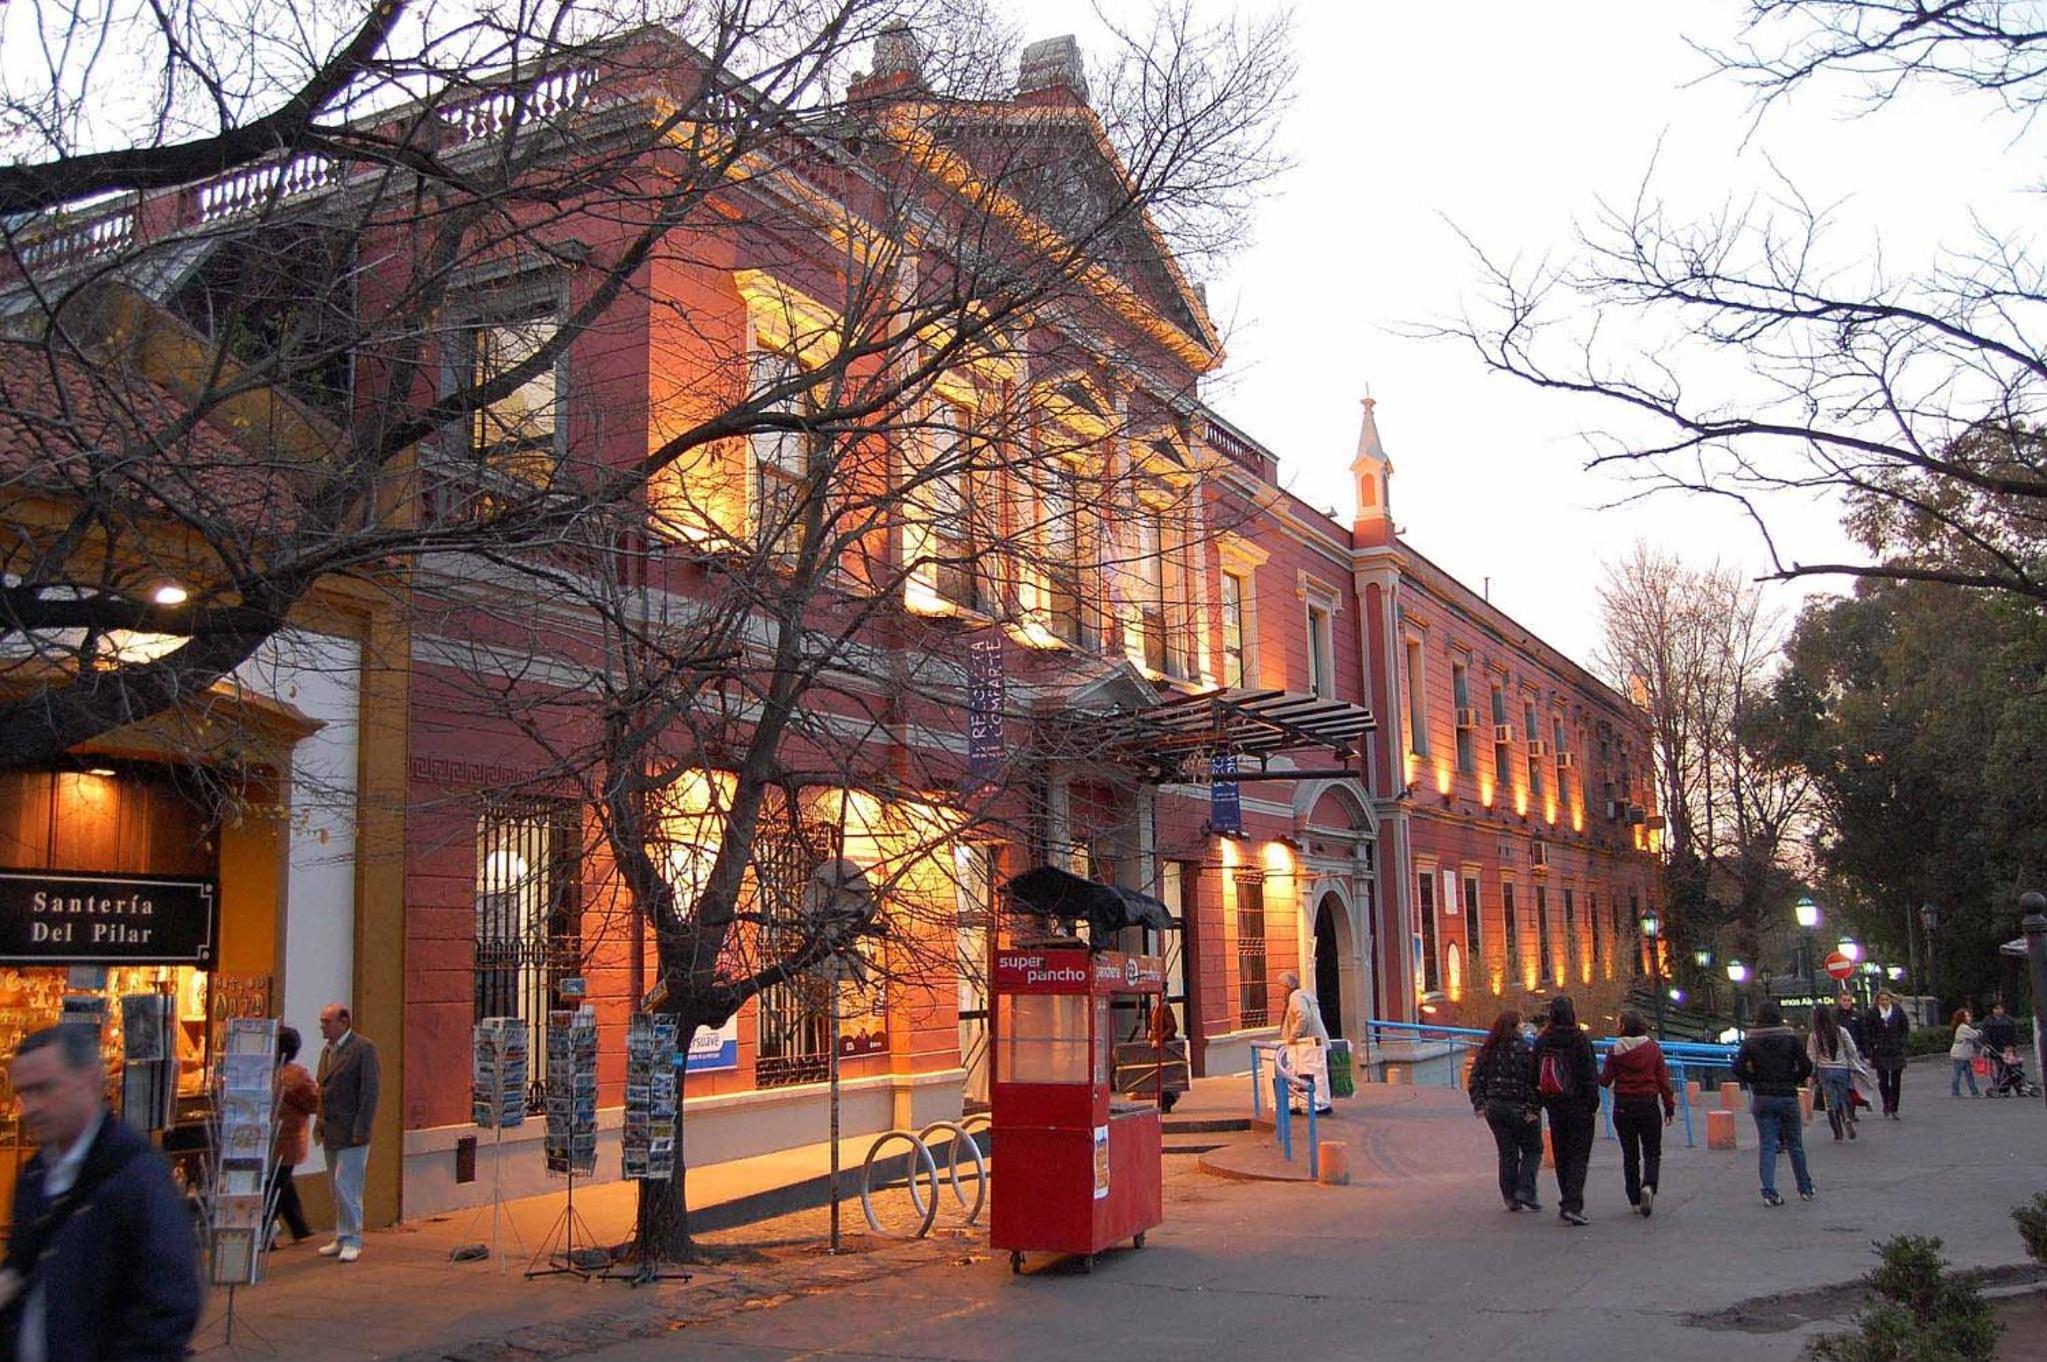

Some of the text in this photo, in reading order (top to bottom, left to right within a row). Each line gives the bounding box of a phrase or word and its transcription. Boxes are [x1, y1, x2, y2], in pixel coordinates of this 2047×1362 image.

[33, 892, 153, 914] Santería
[32, 922, 152, 943] Del Pilar
[999, 956, 1046, 970] super
[1027, 966, 1086, 984] pancho
[692, 1035, 721, 1048] rsuave
